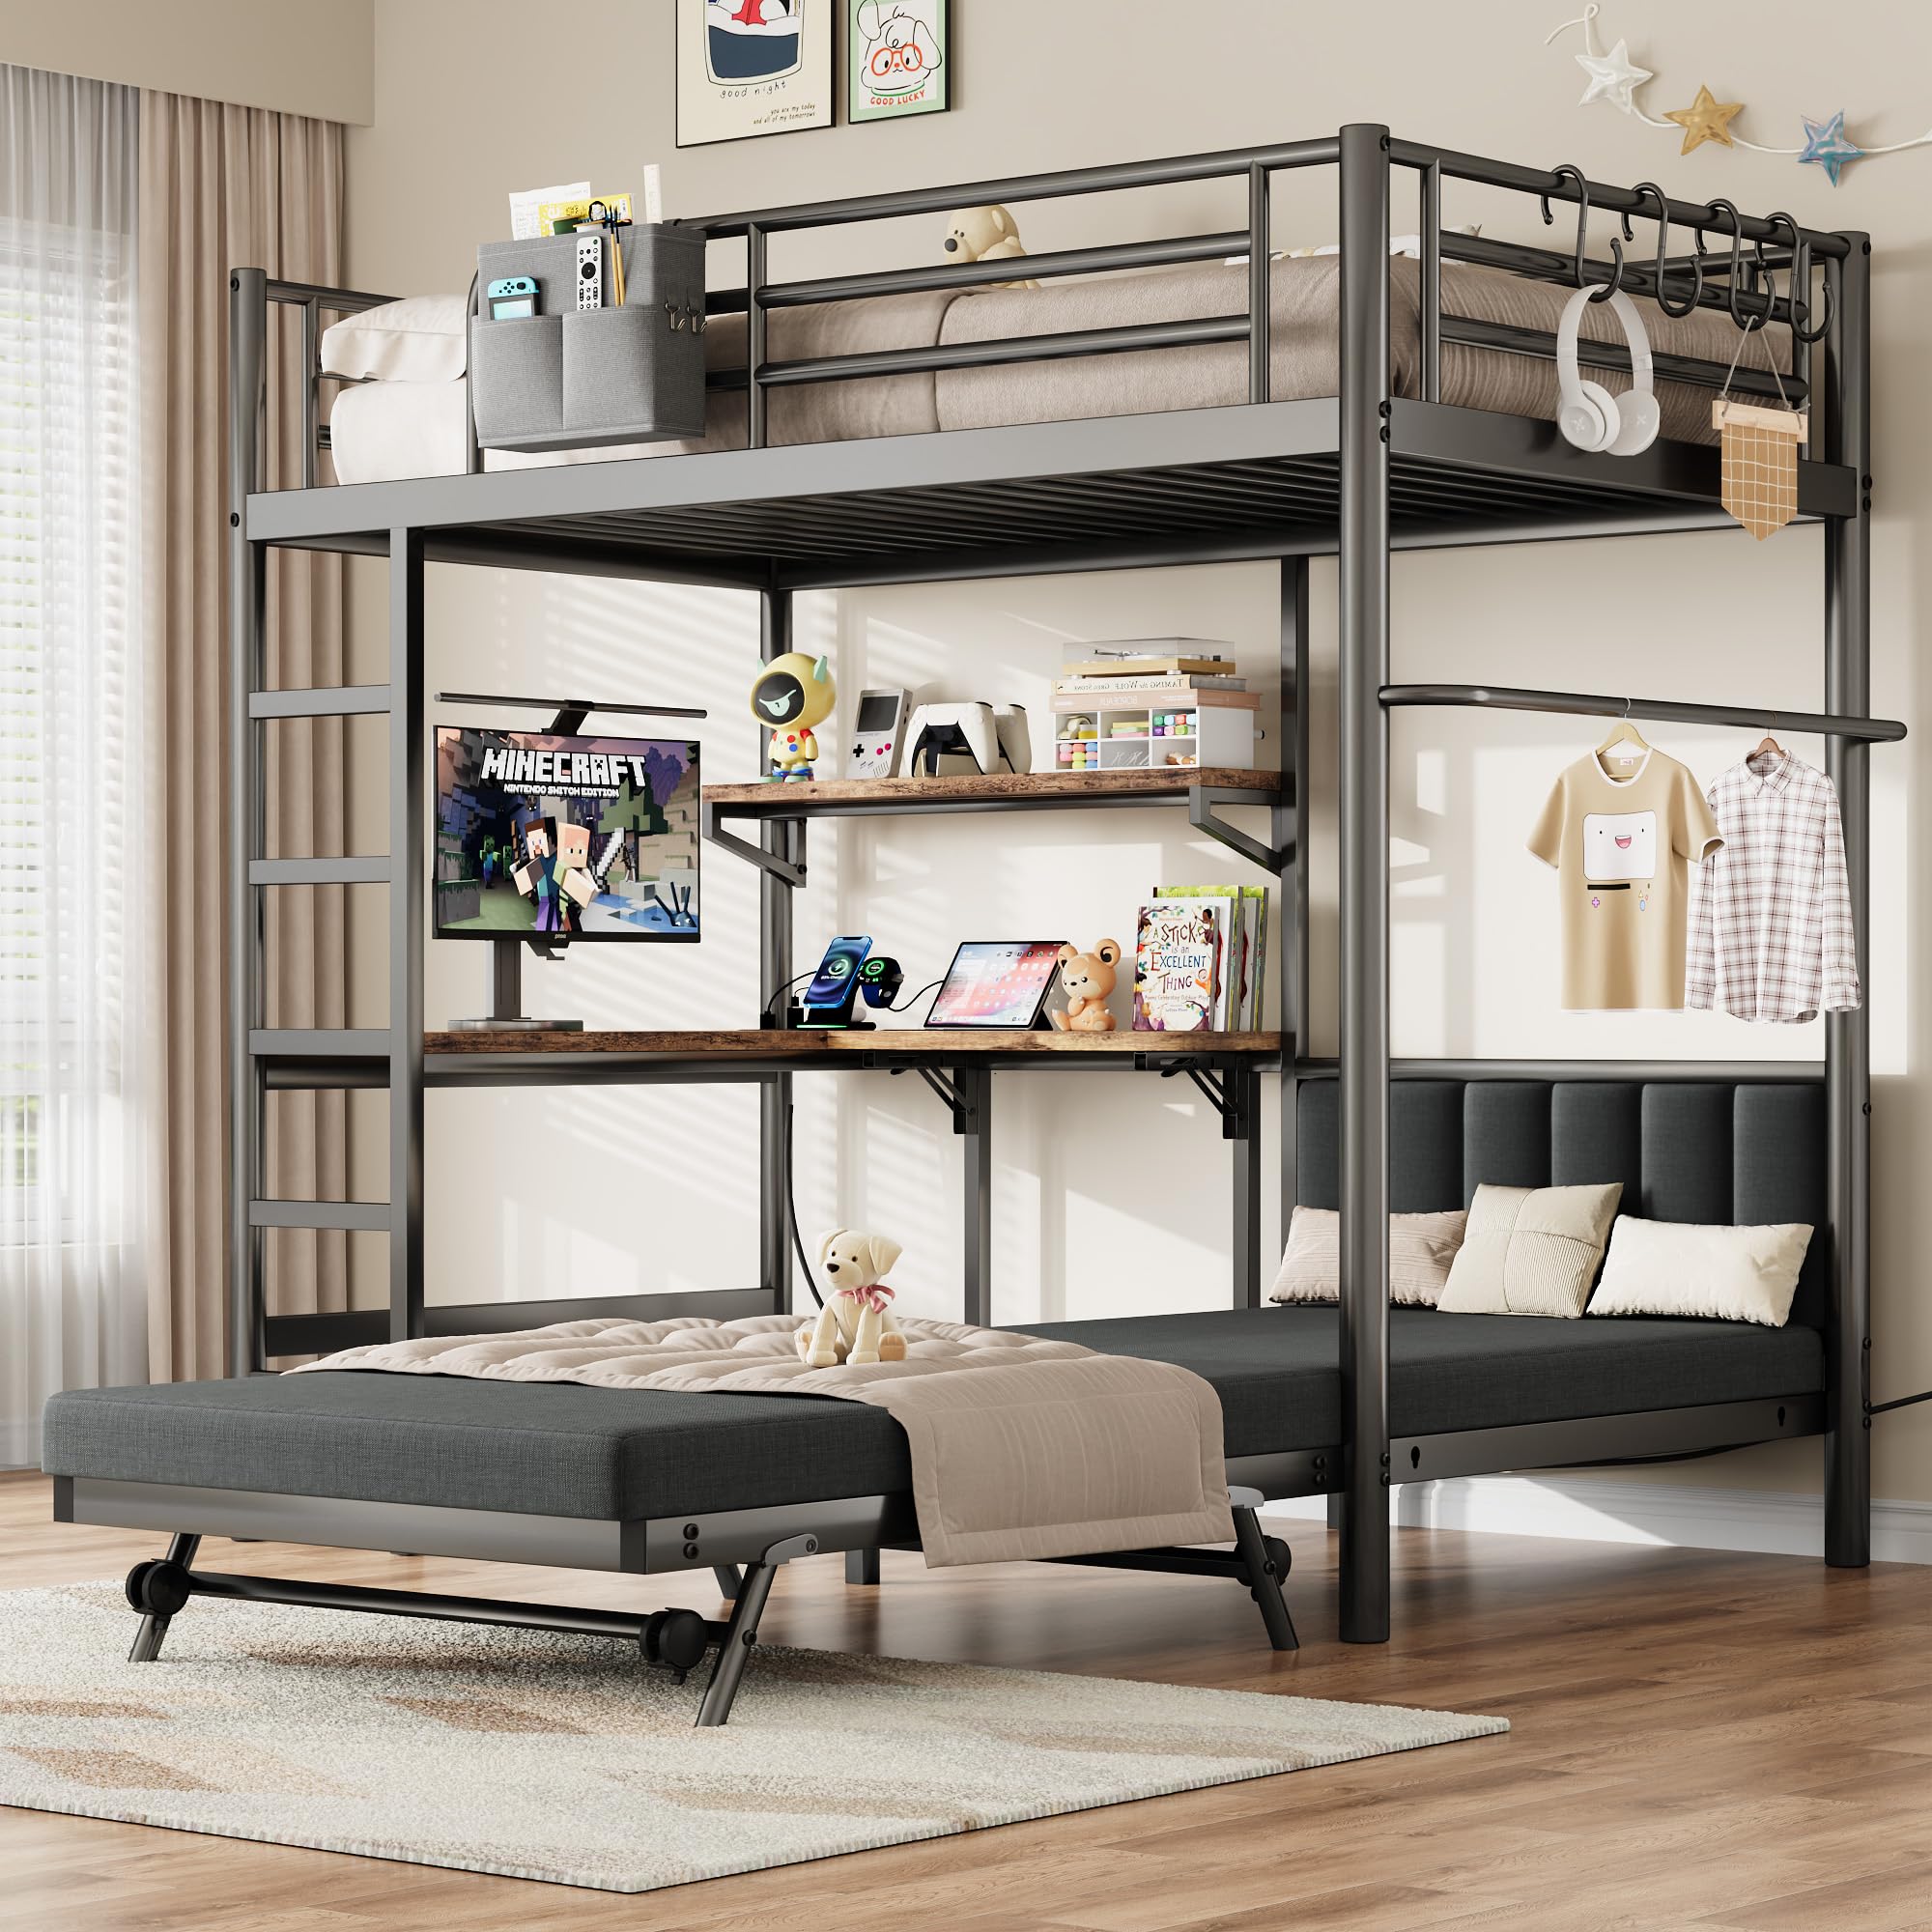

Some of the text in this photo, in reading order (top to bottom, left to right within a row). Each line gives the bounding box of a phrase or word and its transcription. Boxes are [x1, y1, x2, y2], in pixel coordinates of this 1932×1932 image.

[720, 80, 786, 99] good night
[870, 91, 925, 105] GOOD LUCKY
[480, 748, 646, 788] MINECRAFT
[503, 783, 619, 798] NINTENDO SWITCH EDITION
[1153, 929, 1159, 938] A
[1161, 922, 1197, 946] STICK
[1151, 952, 1207, 971] EXCELLENT
[1157, 972, 1193, 994] THING
